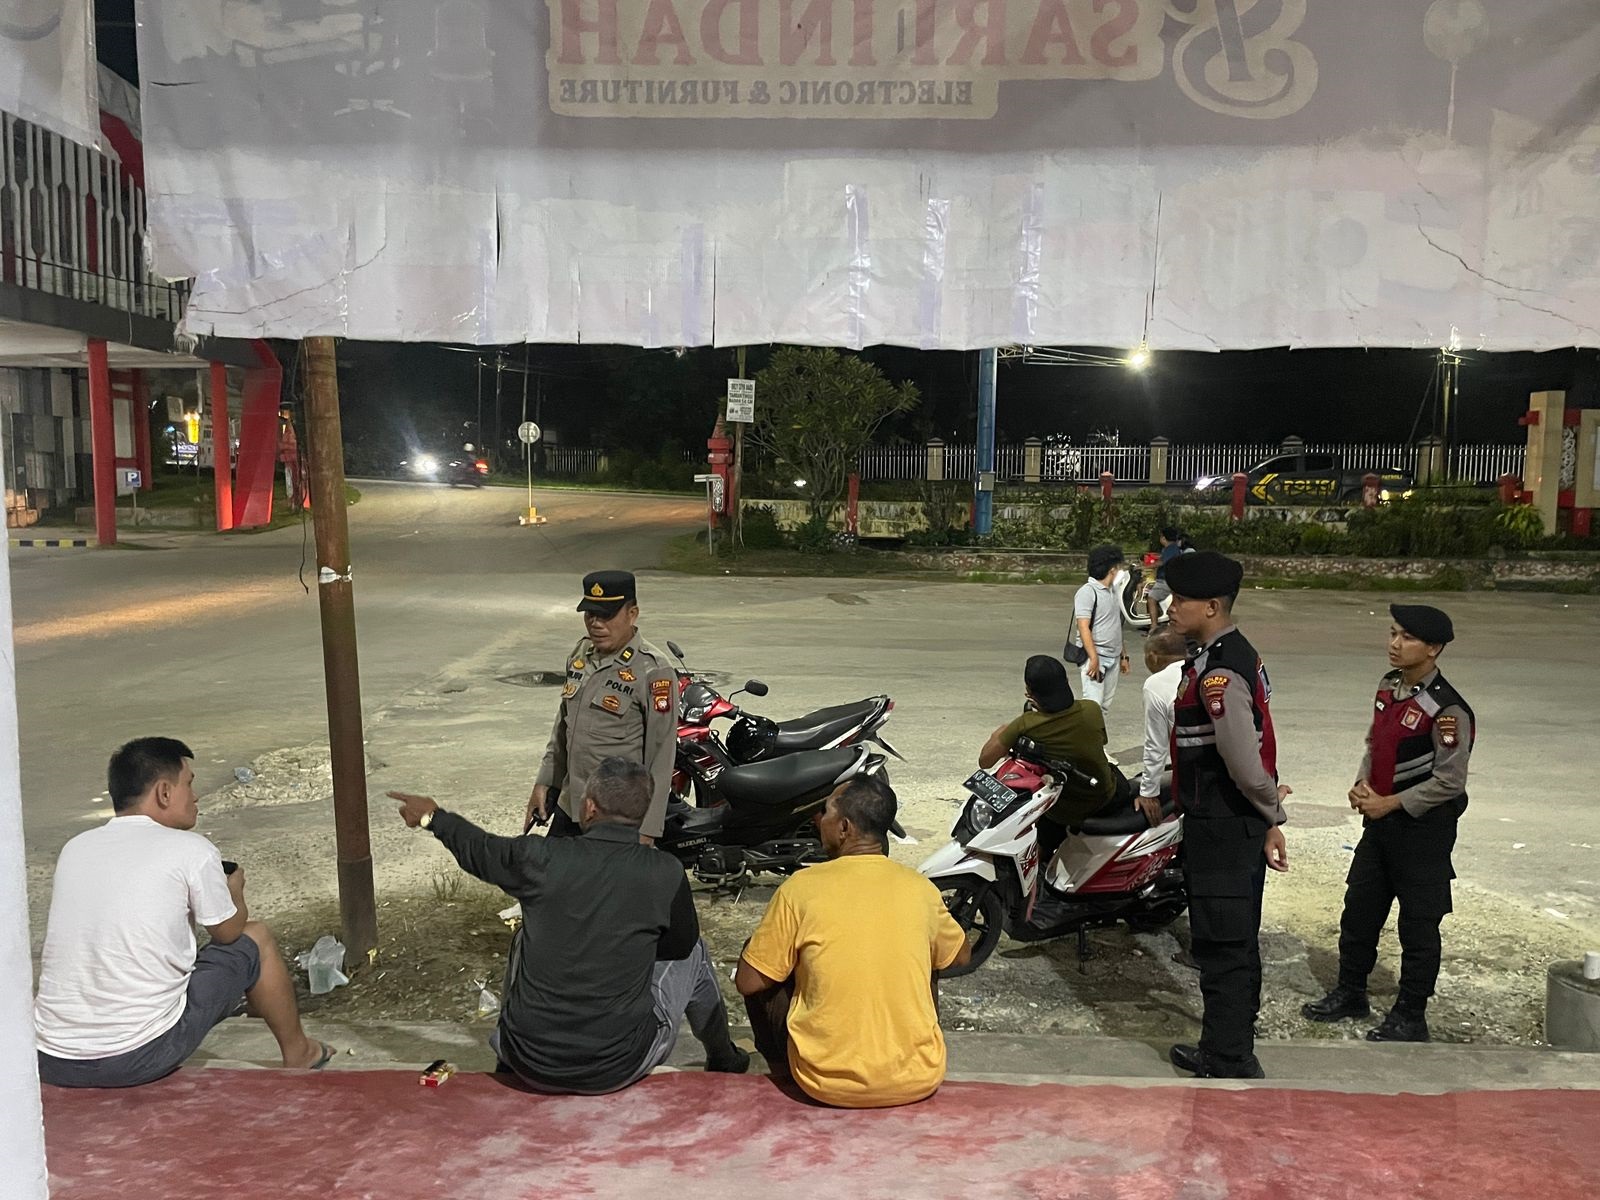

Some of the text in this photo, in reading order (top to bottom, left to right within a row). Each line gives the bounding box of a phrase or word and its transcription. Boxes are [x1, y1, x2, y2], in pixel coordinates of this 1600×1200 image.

[127, 472, 137, 482] P
[1284, 480, 1337, 496] POLISI
[605, 679, 634, 695] POLRI
[677, 837, 707, 848] SUZUKI
